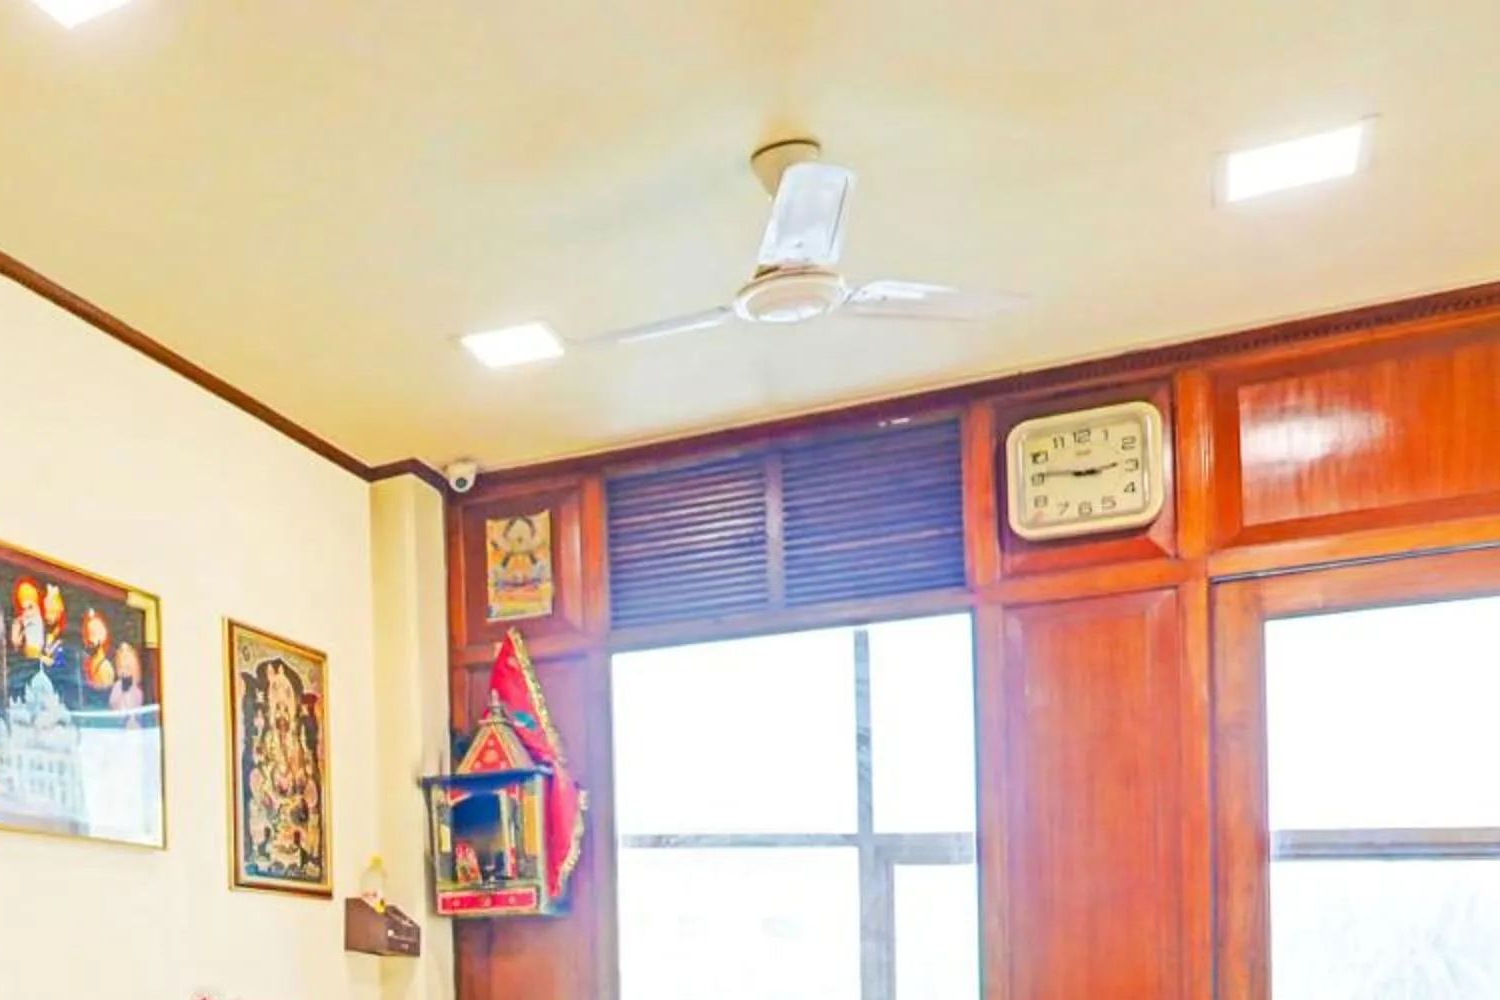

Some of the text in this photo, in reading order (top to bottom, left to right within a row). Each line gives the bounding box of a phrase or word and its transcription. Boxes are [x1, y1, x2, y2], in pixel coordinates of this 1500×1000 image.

[1073, 428, 1091, 444] 12
[1102, 429, 1109, 441] 1
[1053, 437, 1065, 449] 11
[1121, 435, 1137, 450] 2
[1125, 458, 1139, 472] 3
[1031, 473, 1045, 486] 9
[1124, 481, 1137, 494] 4
[1033, 495, 1048, 508] 8
[1057, 501, 1070, 515] 7
[1077, 501, 1093, 516] 6
[1101, 496, 1117, 510] 5
